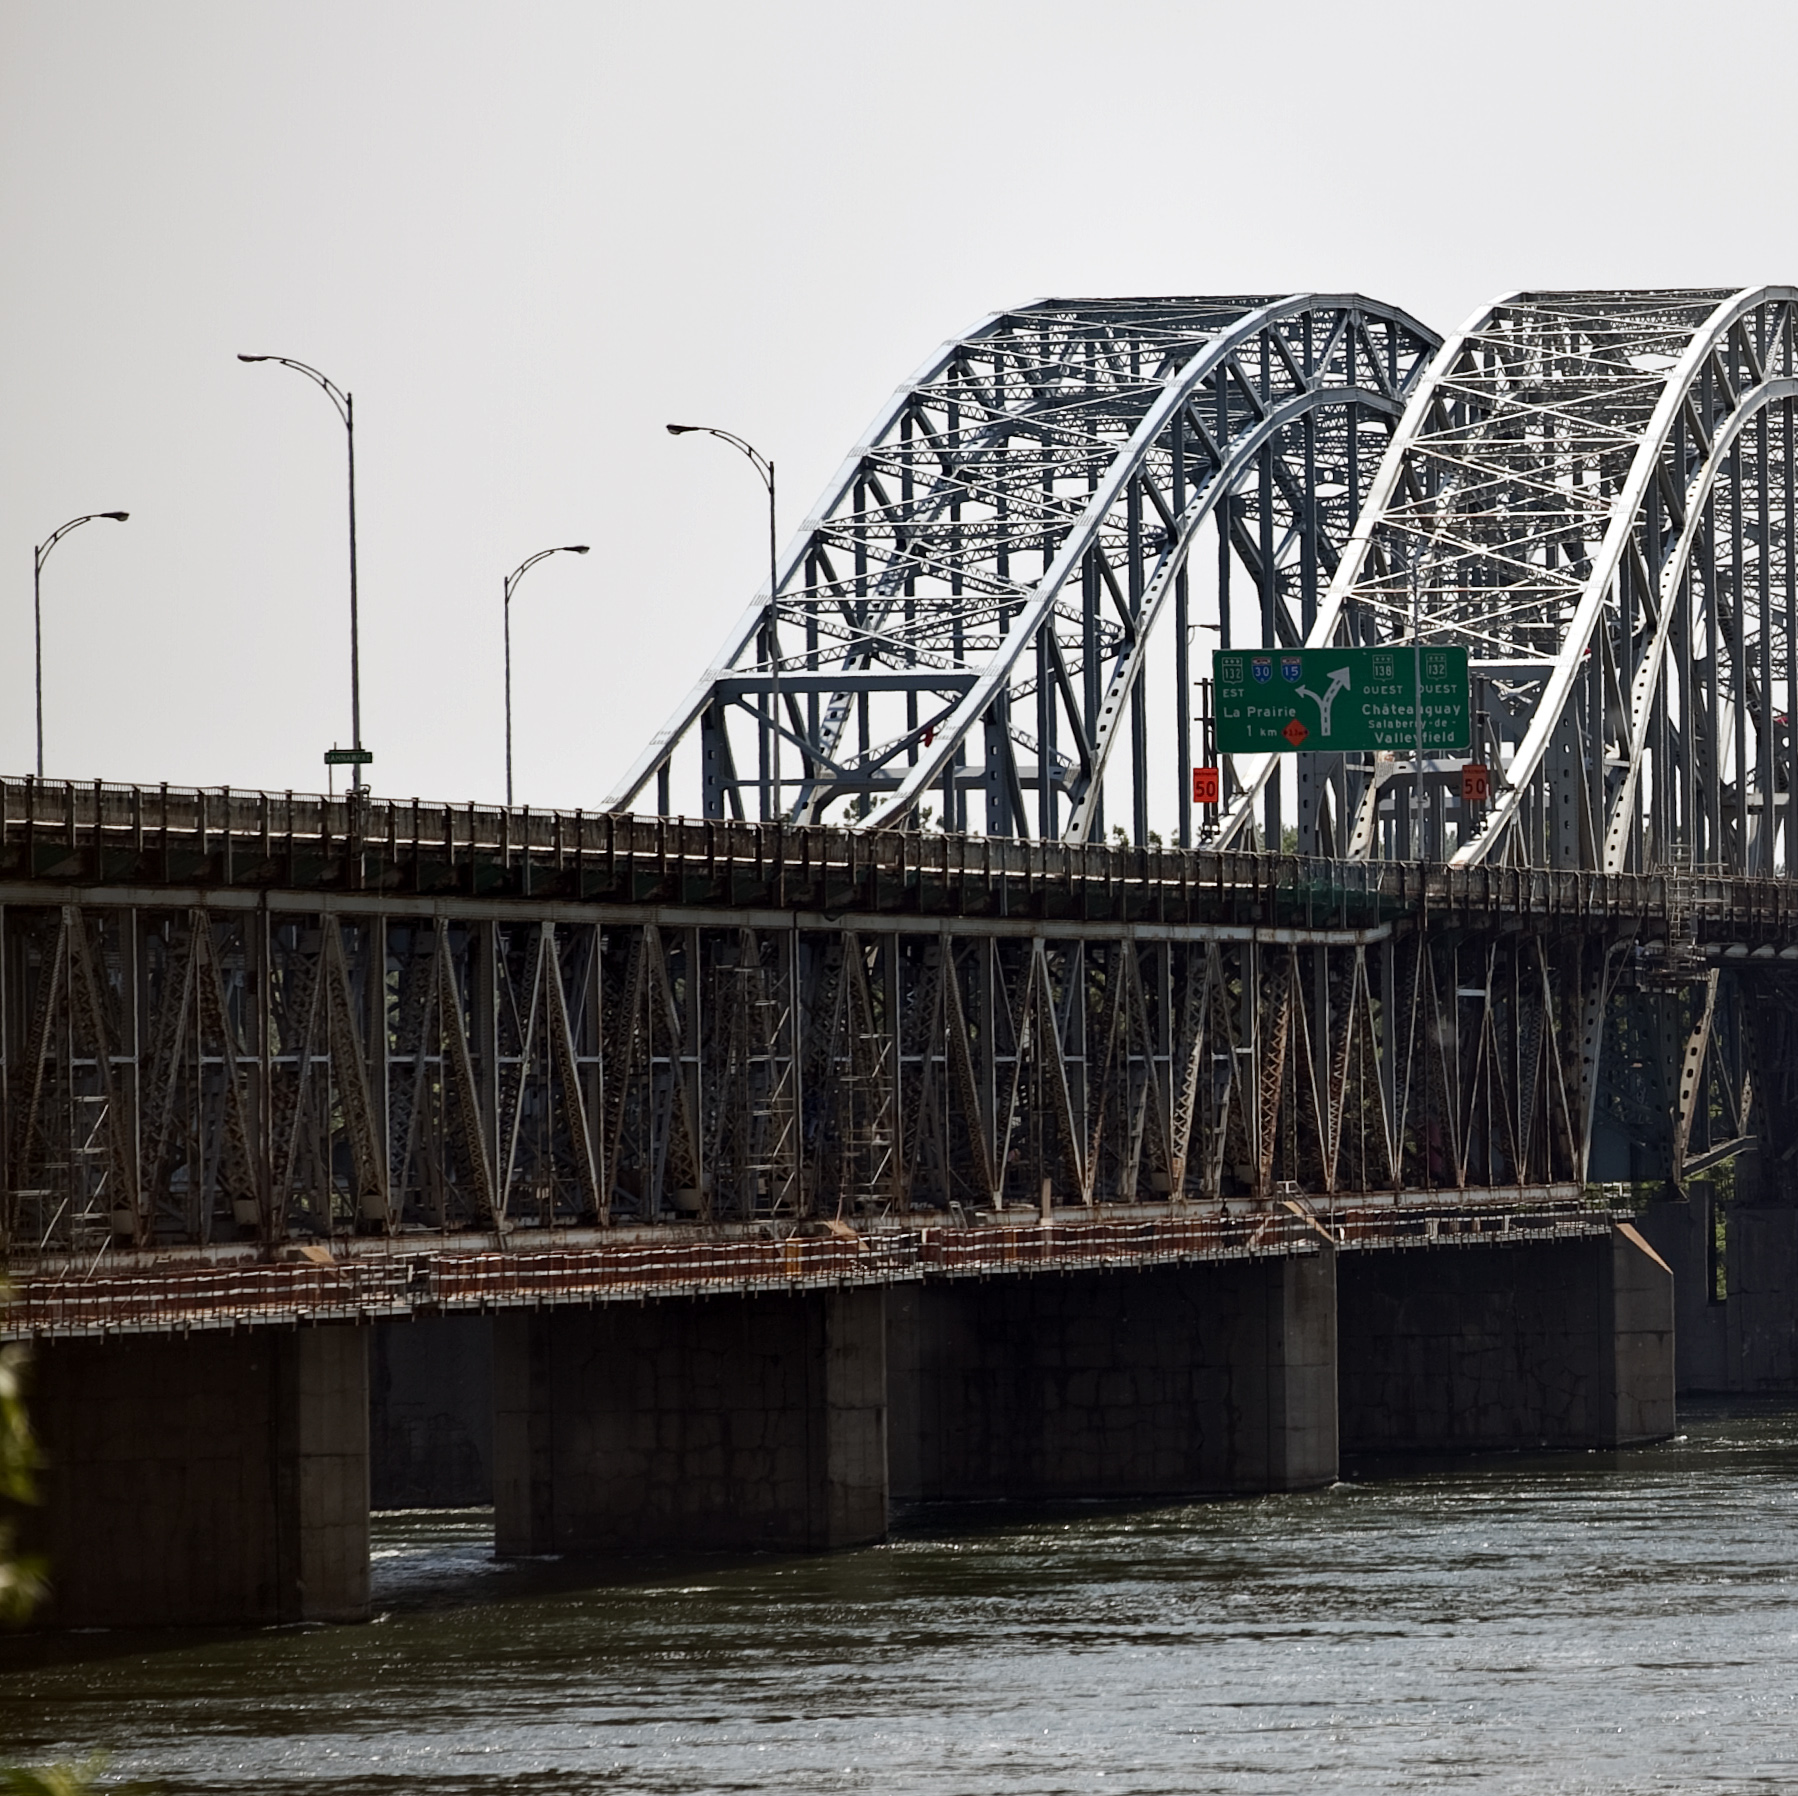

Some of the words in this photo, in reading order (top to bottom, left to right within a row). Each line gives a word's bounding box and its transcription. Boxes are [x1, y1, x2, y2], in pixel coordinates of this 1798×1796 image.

[1225, 668, 1241, 679] 132
[1255, 667, 1270, 677] 30
[1284, 666, 1299, 676] 15
[1374, 665, 1392, 677] 138
[1428, 664, 1445, 675] 132
[1222, 688, 1245, 698] EST
[1363, 685, 1403, 695] OUEST
[1418, 684, 1458, 694] OUEST
[1223, 706, 1241, 718] La
[1246, 705, 1297, 718] Prairie
[1246, 724, 1252, 737] 1
[1259, 727, 1278, 737] km
[1196, 780, 1216, 797] 50
[1465, 778, 1485, 794] 50
